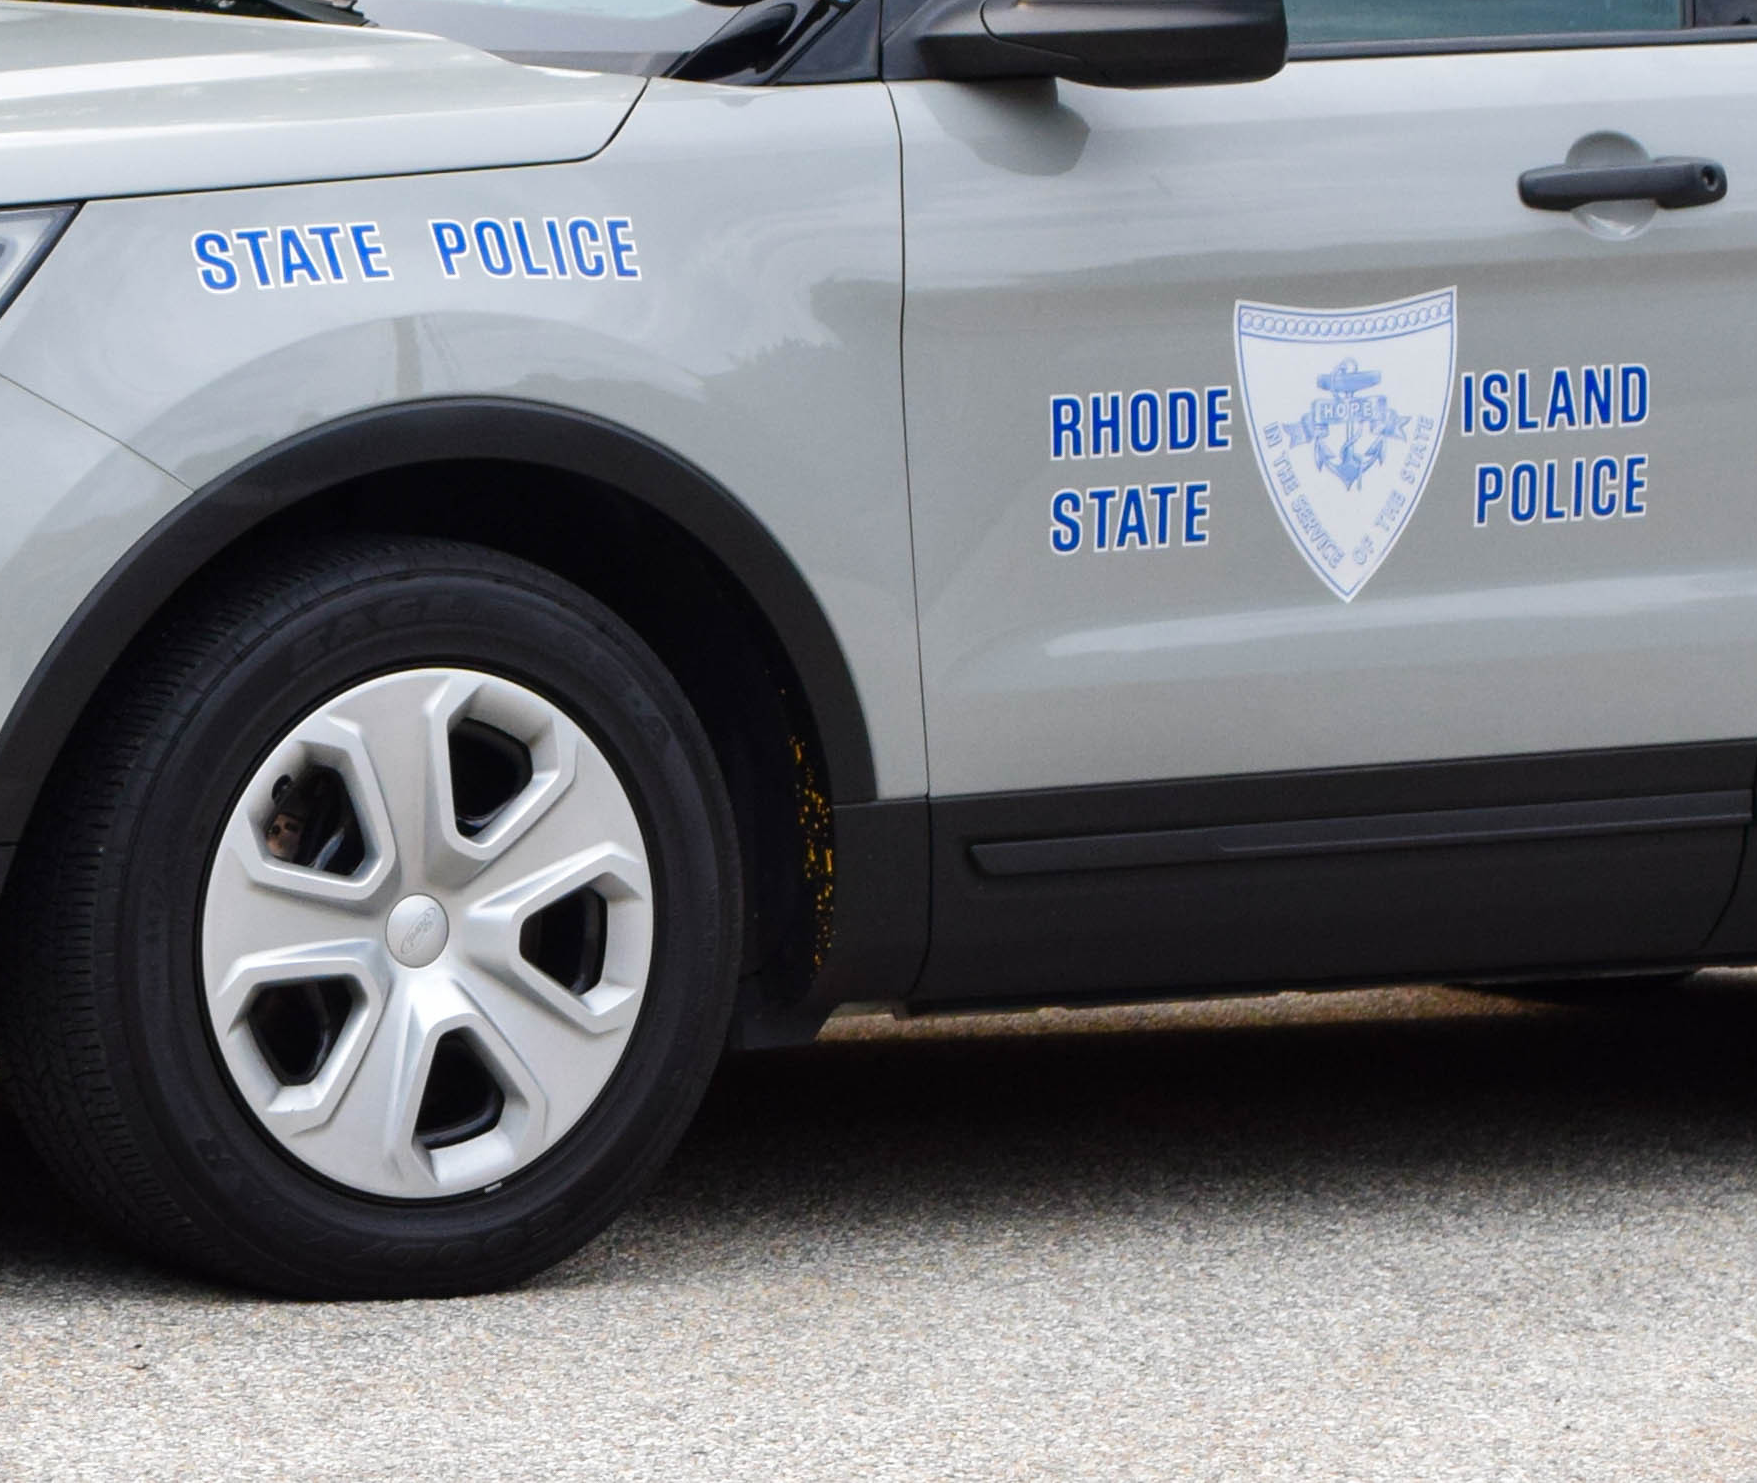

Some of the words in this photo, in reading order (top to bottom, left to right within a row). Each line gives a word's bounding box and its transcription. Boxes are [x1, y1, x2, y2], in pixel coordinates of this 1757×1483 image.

[193, 222, 392, 292] STATE
[430, 218, 640, 280] POLICE
[1051, 386, 1231, 459] RHODE
[1461, 364, 1648, 435] ISLAND
[1325, 402, 1372, 417] HOPE
[1051, 481, 1209, 554] STATE
[1475, 455, 1648, 526] POLICE
[1265, 423, 1281, 447] IN
[1275, 451, 1298, 494] THE
[1292, 495, 1344, 567] SERVICE
[1355, 536, 1373, 564] OF
[1376, 491, 1405, 531] THE
[1402, 418, 1433, 483] STATE
